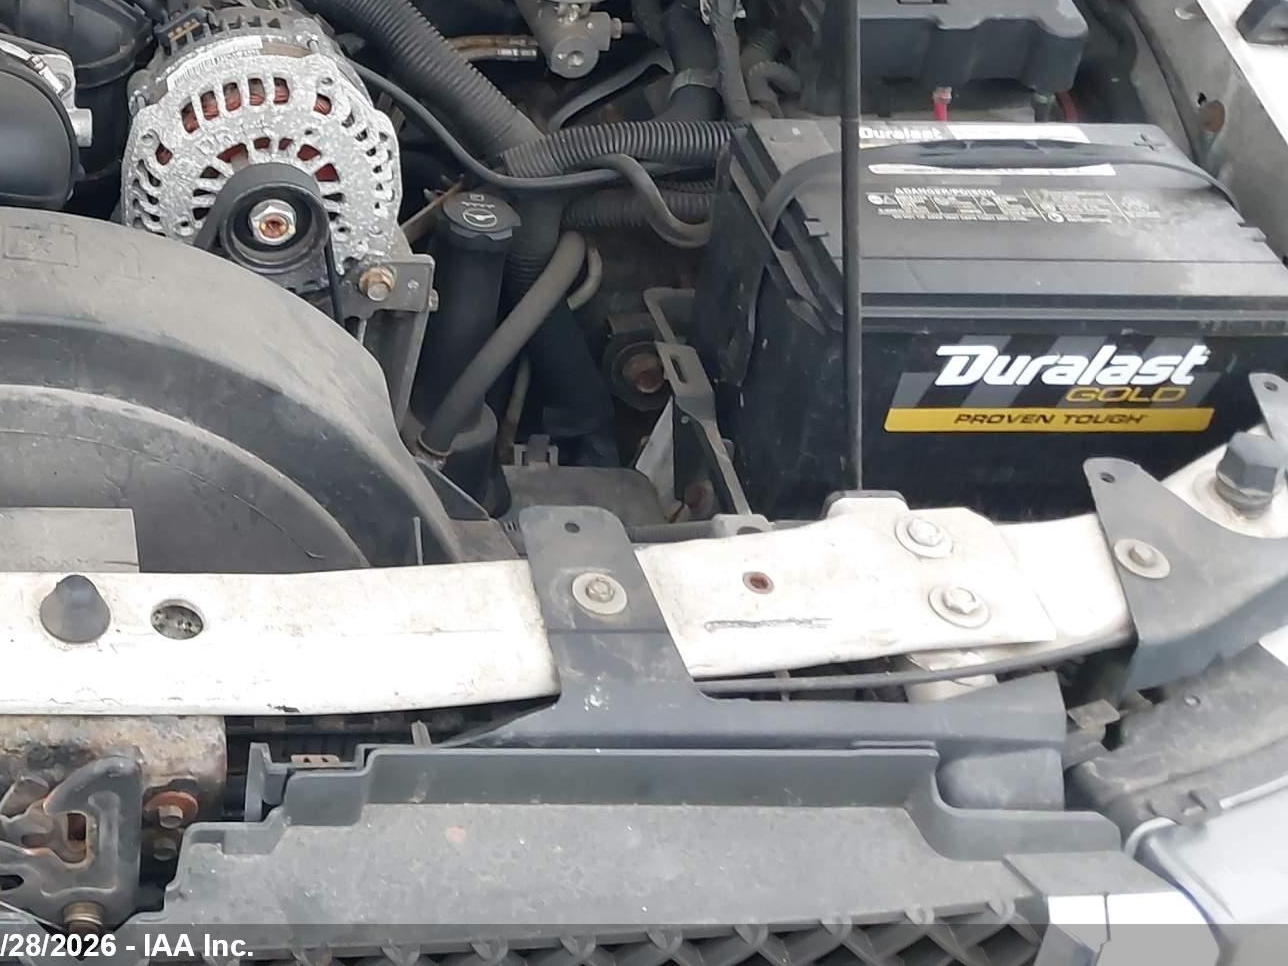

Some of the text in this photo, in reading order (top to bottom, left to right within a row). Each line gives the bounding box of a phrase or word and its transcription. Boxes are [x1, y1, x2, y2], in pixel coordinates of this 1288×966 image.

[935, 345, 1210, 385] Duralast
[1066, 387, 1187, 403] GOLD
[954, 414, 1143, 425] PROVEN TOUGH
